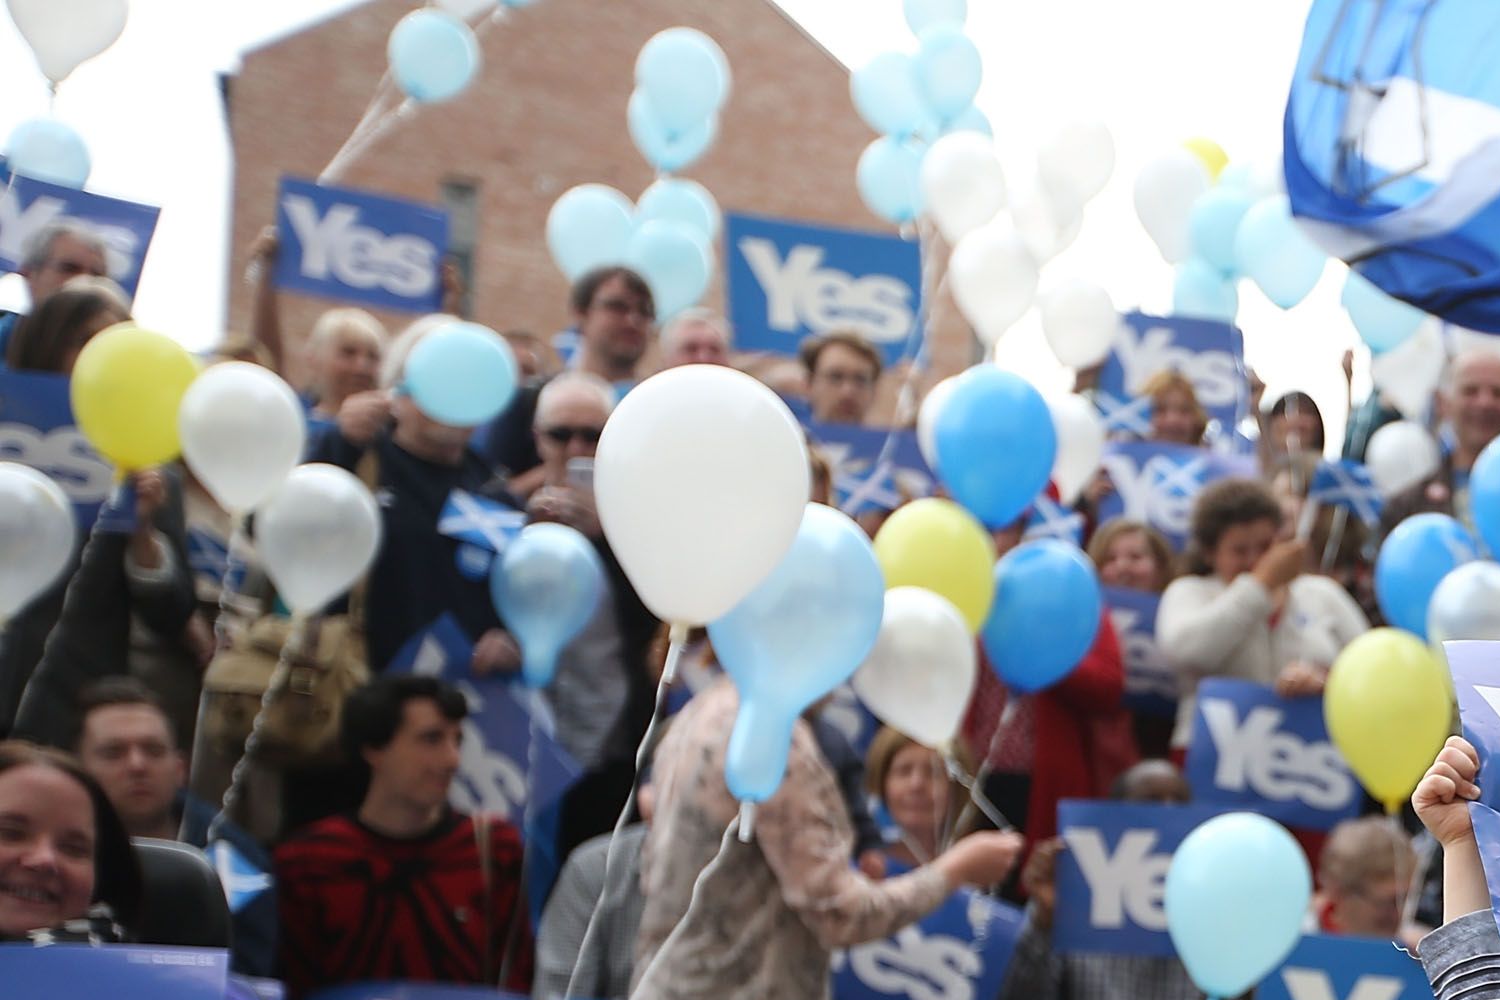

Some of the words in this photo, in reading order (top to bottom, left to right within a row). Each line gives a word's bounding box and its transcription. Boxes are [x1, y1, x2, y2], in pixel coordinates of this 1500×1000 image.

[284, 196, 437, 298] Yes
[739, 237, 914, 344] Yes
[1202, 698, 1353, 809] Yes
